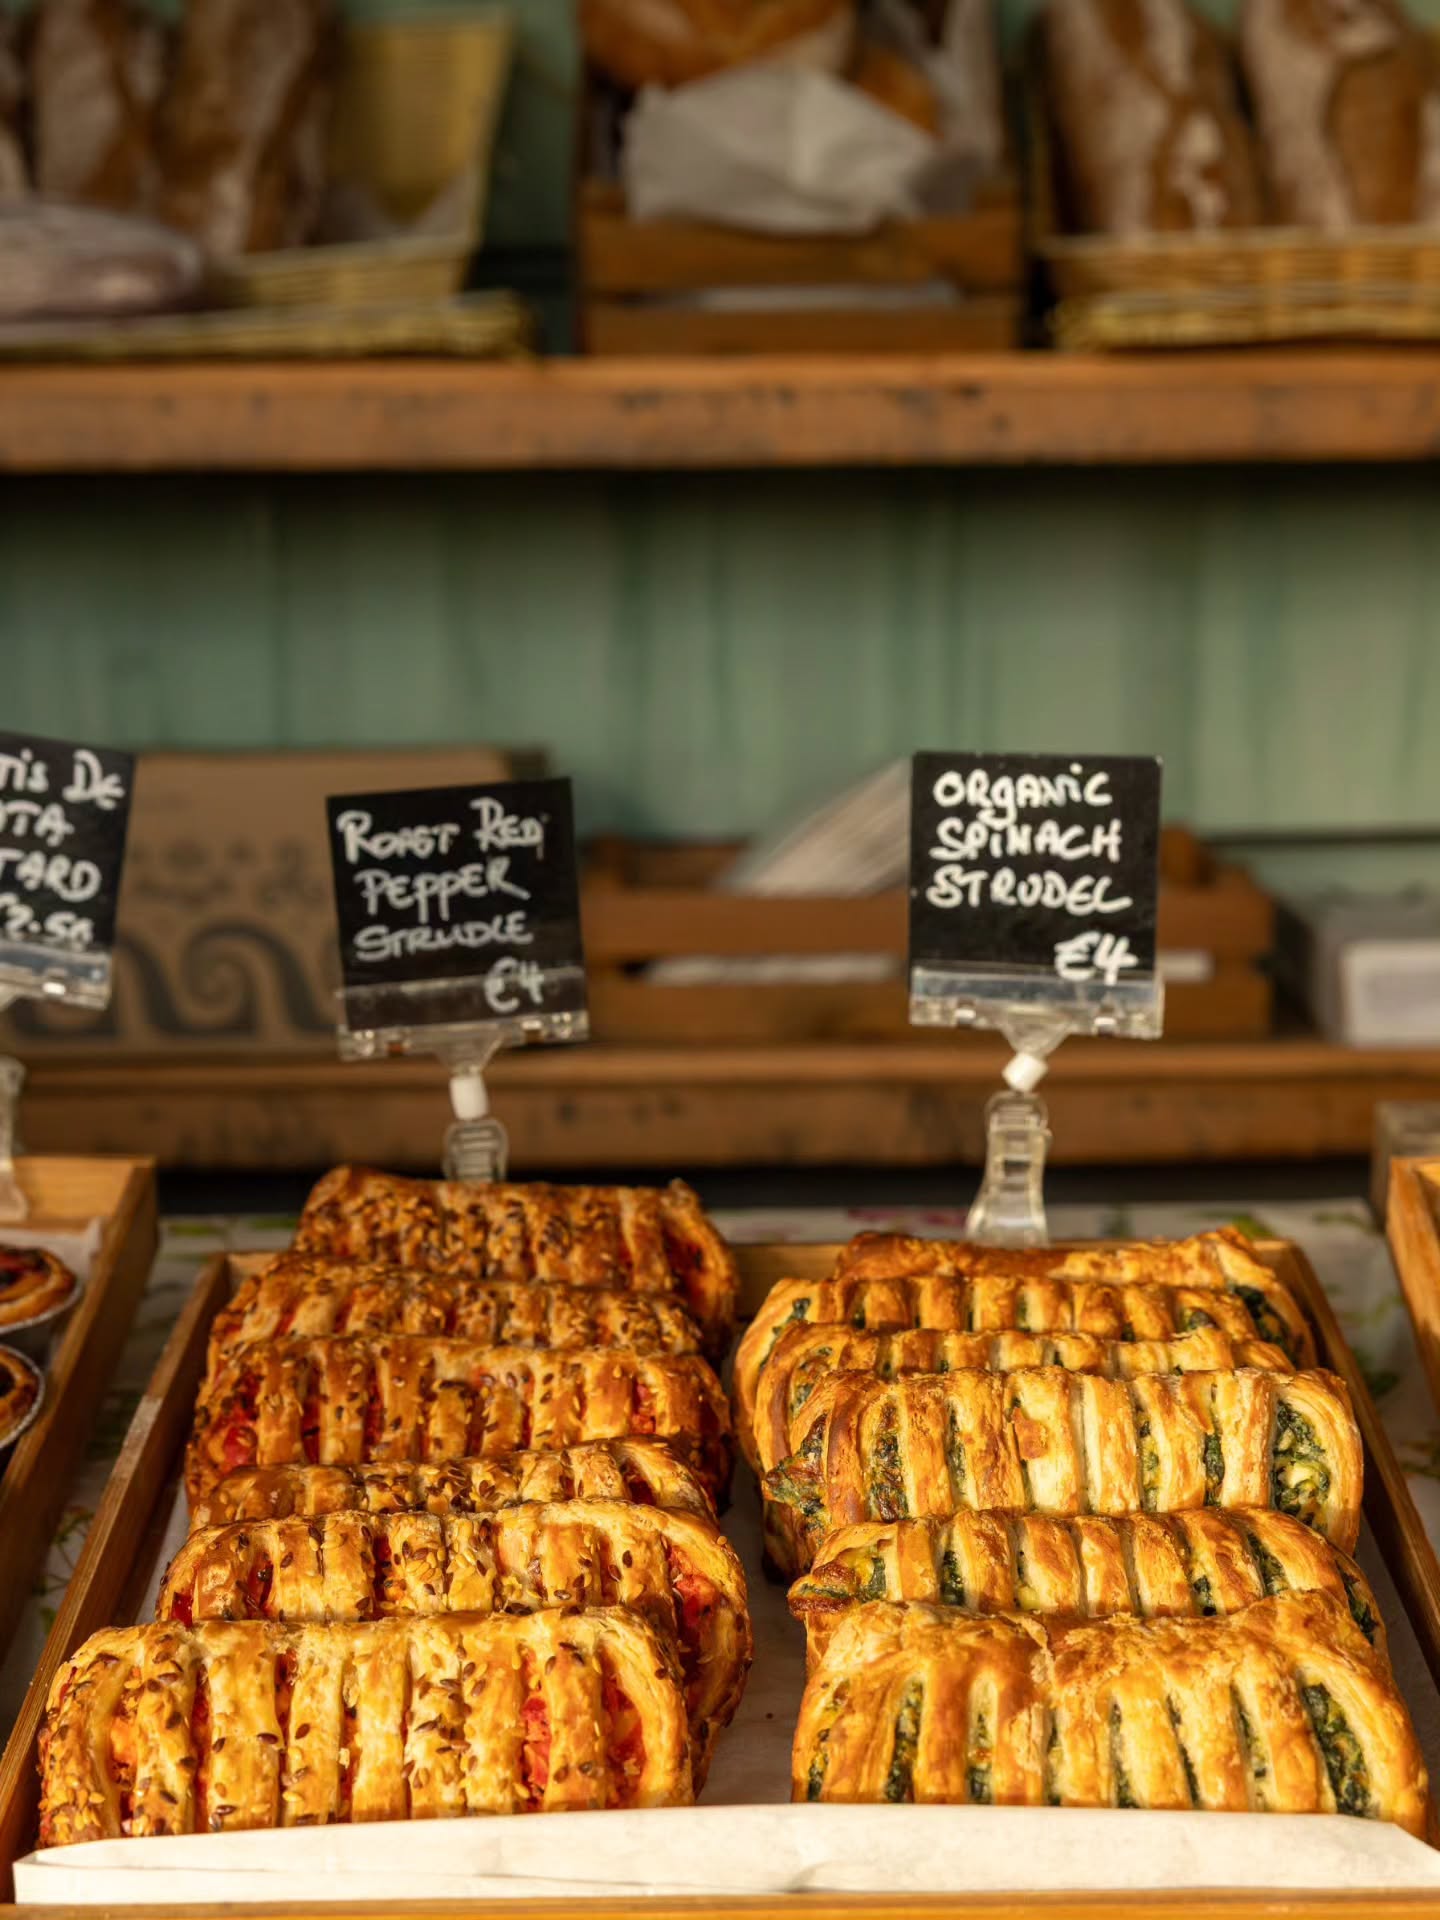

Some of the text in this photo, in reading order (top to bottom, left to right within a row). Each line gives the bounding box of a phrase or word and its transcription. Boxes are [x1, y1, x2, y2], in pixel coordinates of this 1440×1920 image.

[0, 800, 75, 847] TA
[353, 855, 531, 924] PEPPER
[926, 864, 1133, 915] STRUDEL
[353, 910, 534, 962] STRUDLE
[484, 956, 545, 1012] €4
